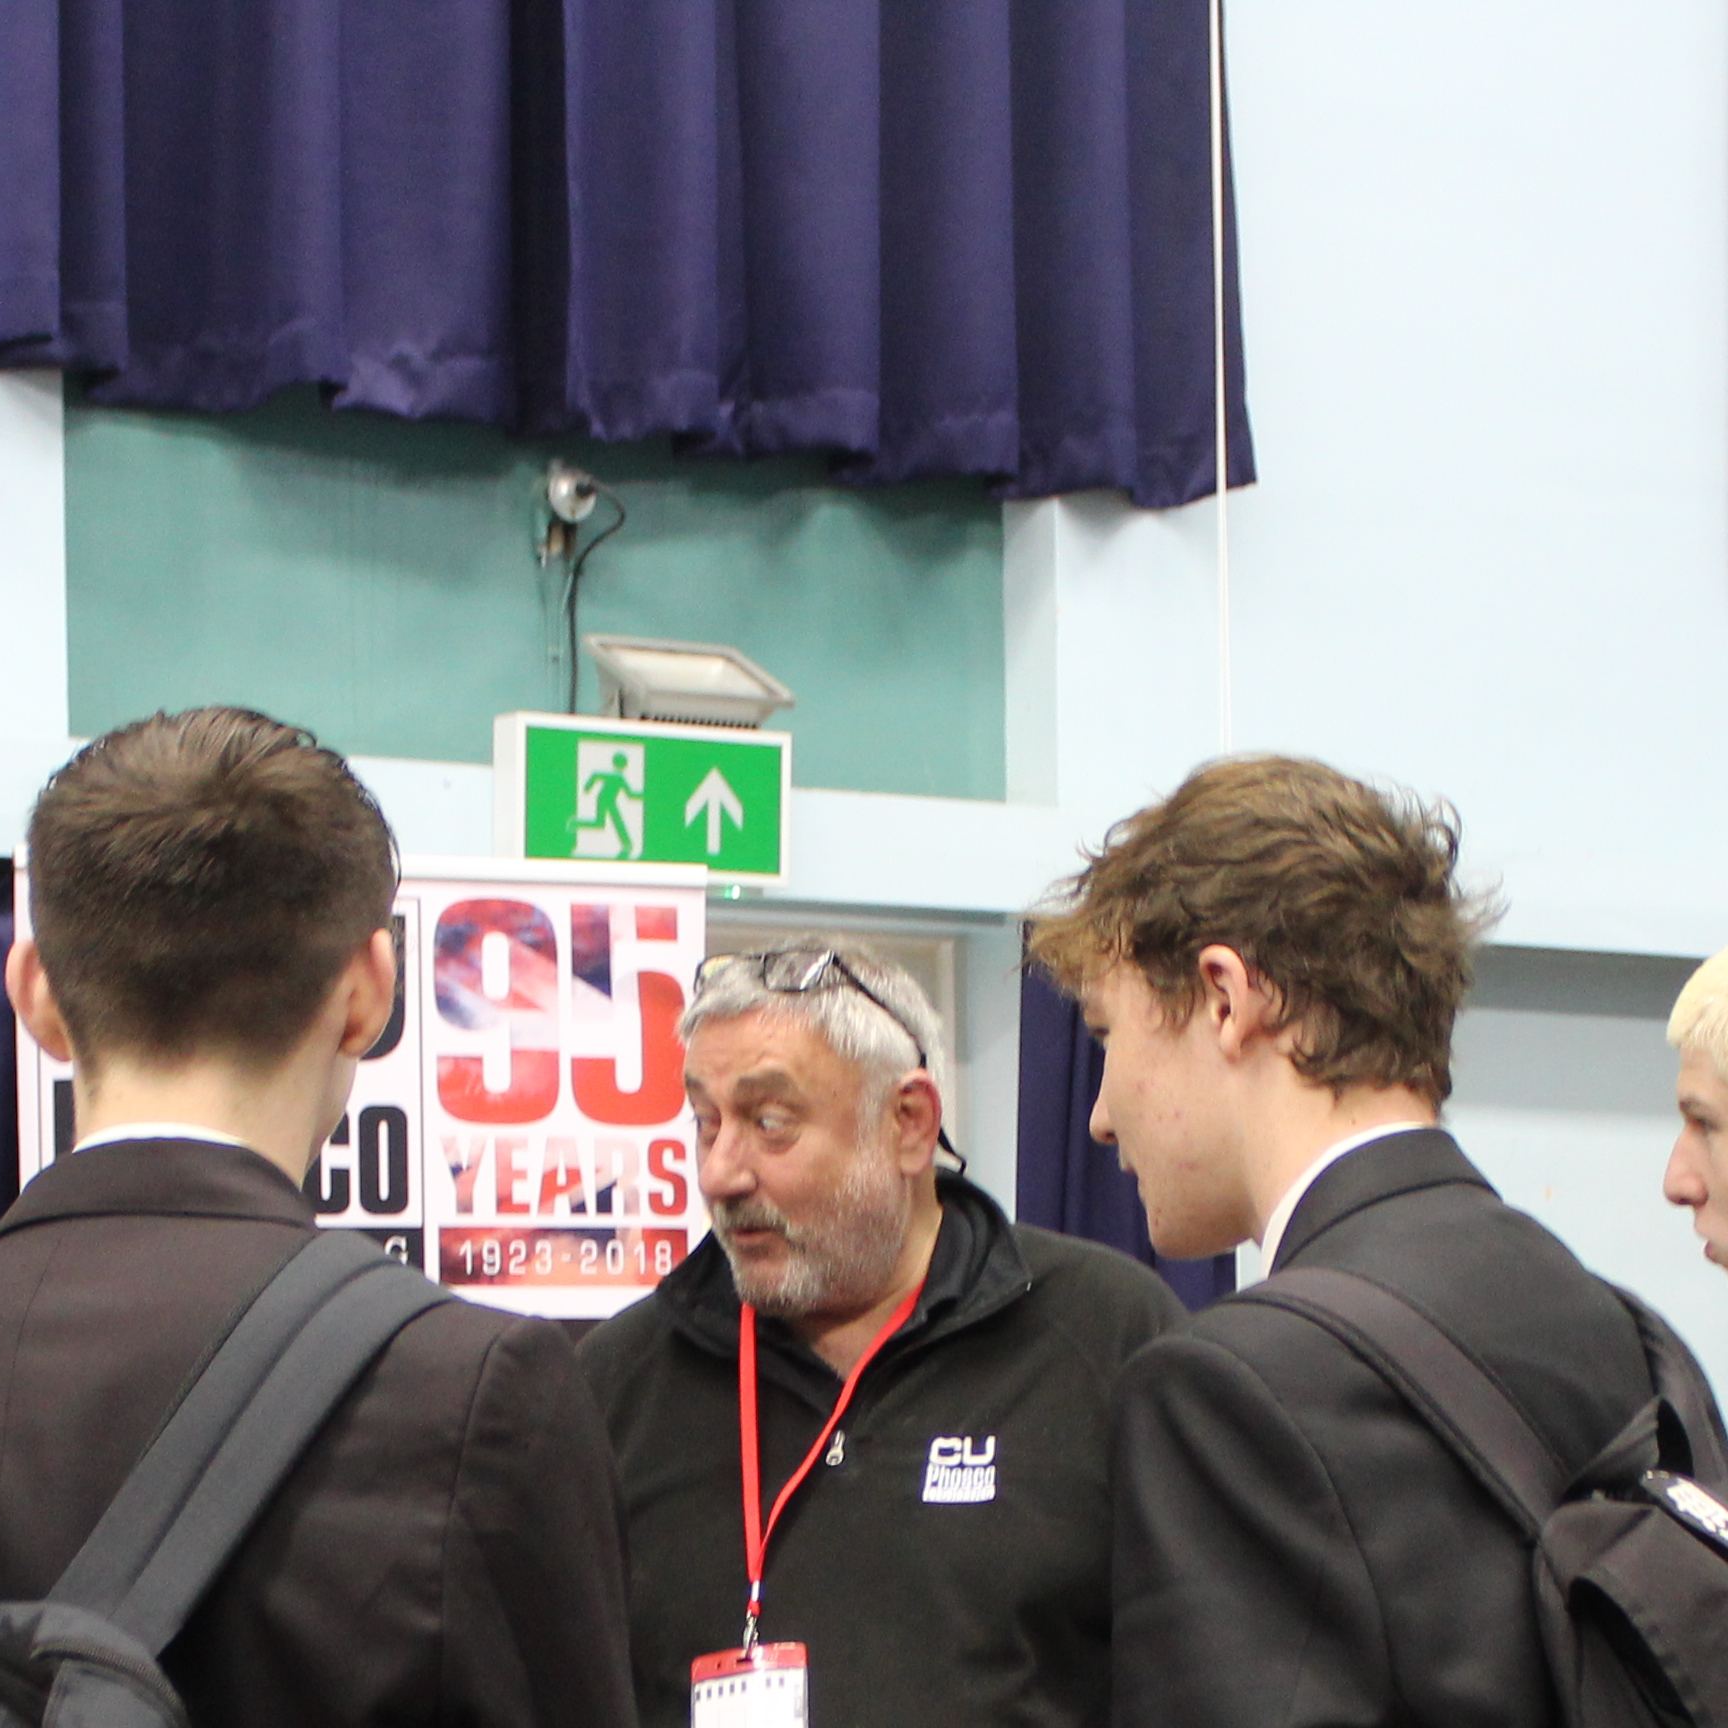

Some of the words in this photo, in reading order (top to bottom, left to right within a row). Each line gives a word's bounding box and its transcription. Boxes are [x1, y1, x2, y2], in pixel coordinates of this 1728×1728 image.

[434, 898, 686, 1126] 95
[440, 1136, 688, 1217] YEARS
[459, 1239, 672, 1277] 1923-2018
[929, 1435, 996, 1467] CU
